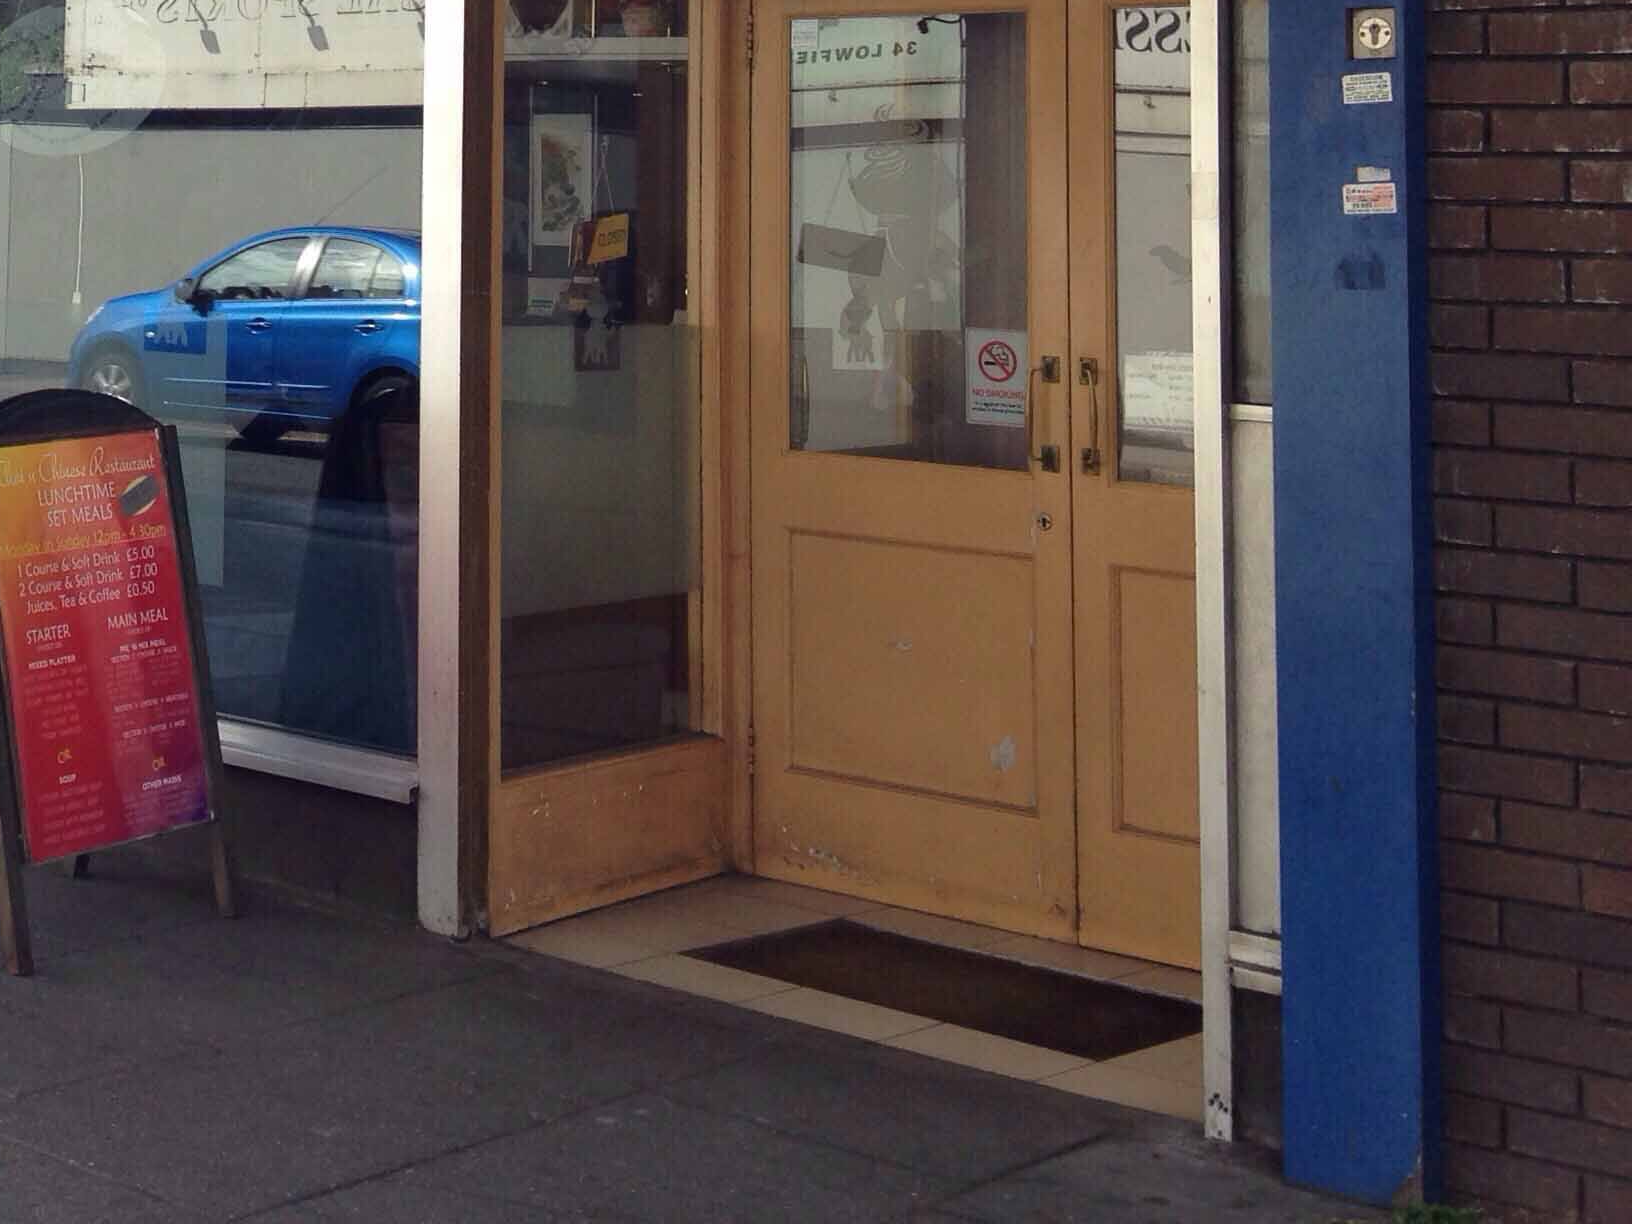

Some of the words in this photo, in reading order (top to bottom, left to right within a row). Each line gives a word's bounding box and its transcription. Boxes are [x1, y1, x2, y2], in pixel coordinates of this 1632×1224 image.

[89, 446, 155, 476] Restaurant
[38, 482, 116, 507] LUNCHTIME
[48, 509, 66, 528] SET
[72, 504, 113, 524] MEALS
[25, 559, 60, 577] Course
[71, 554, 90, 570] Soft
[93, 551, 121, 568] Drink
[126, 545, 154, 562] £5.00
[19, 583, 26, 597] 2
[28, 579, 62, 595] Course
[74, 572, 93, 588] Soft
[96, 568, 124, 585] Drink
[129, 562, 158, 580] £7.00
[59, 593, 77, 608] Tea
[78, 592, 88, 606] &
[89, 587, 121, 604] Coffee
[126, 581, 155, 598] £0.50
[107, 613, 138, 630] MAIN
[140, 607, 169, 625] MEAL
[25, 624, 71, 645] STARTER
